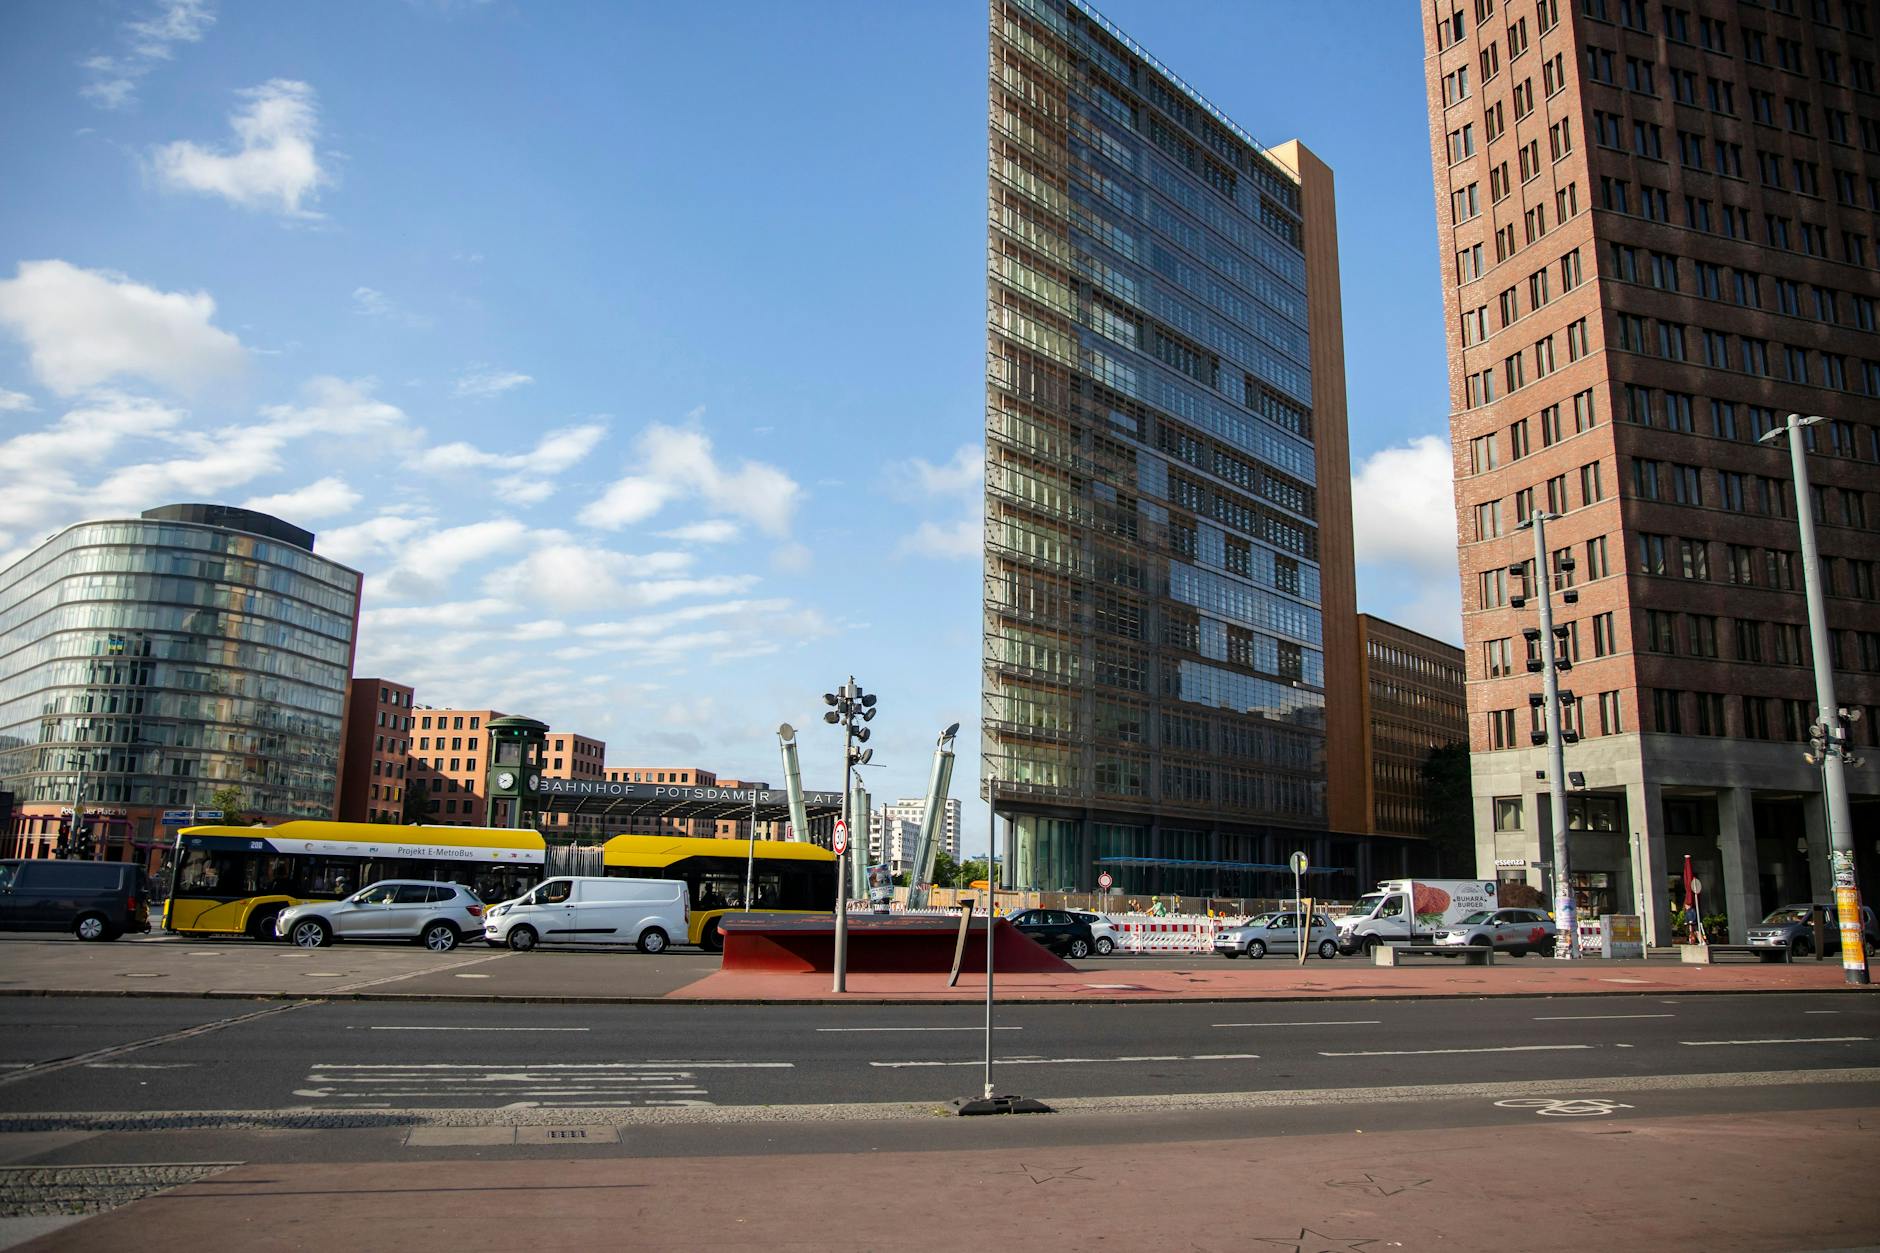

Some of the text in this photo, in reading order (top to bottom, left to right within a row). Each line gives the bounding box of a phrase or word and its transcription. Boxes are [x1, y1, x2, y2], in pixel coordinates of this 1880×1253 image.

[540, 780, 844, 805] BAHNHOF POTSDAMER LATZ
[97, 808, 115, 816] Platz
[118, 808, 127, 816] 10
[836, 829, 844, 845] 30
[397, 847, 474, 857] Projekt E-MetroBus
